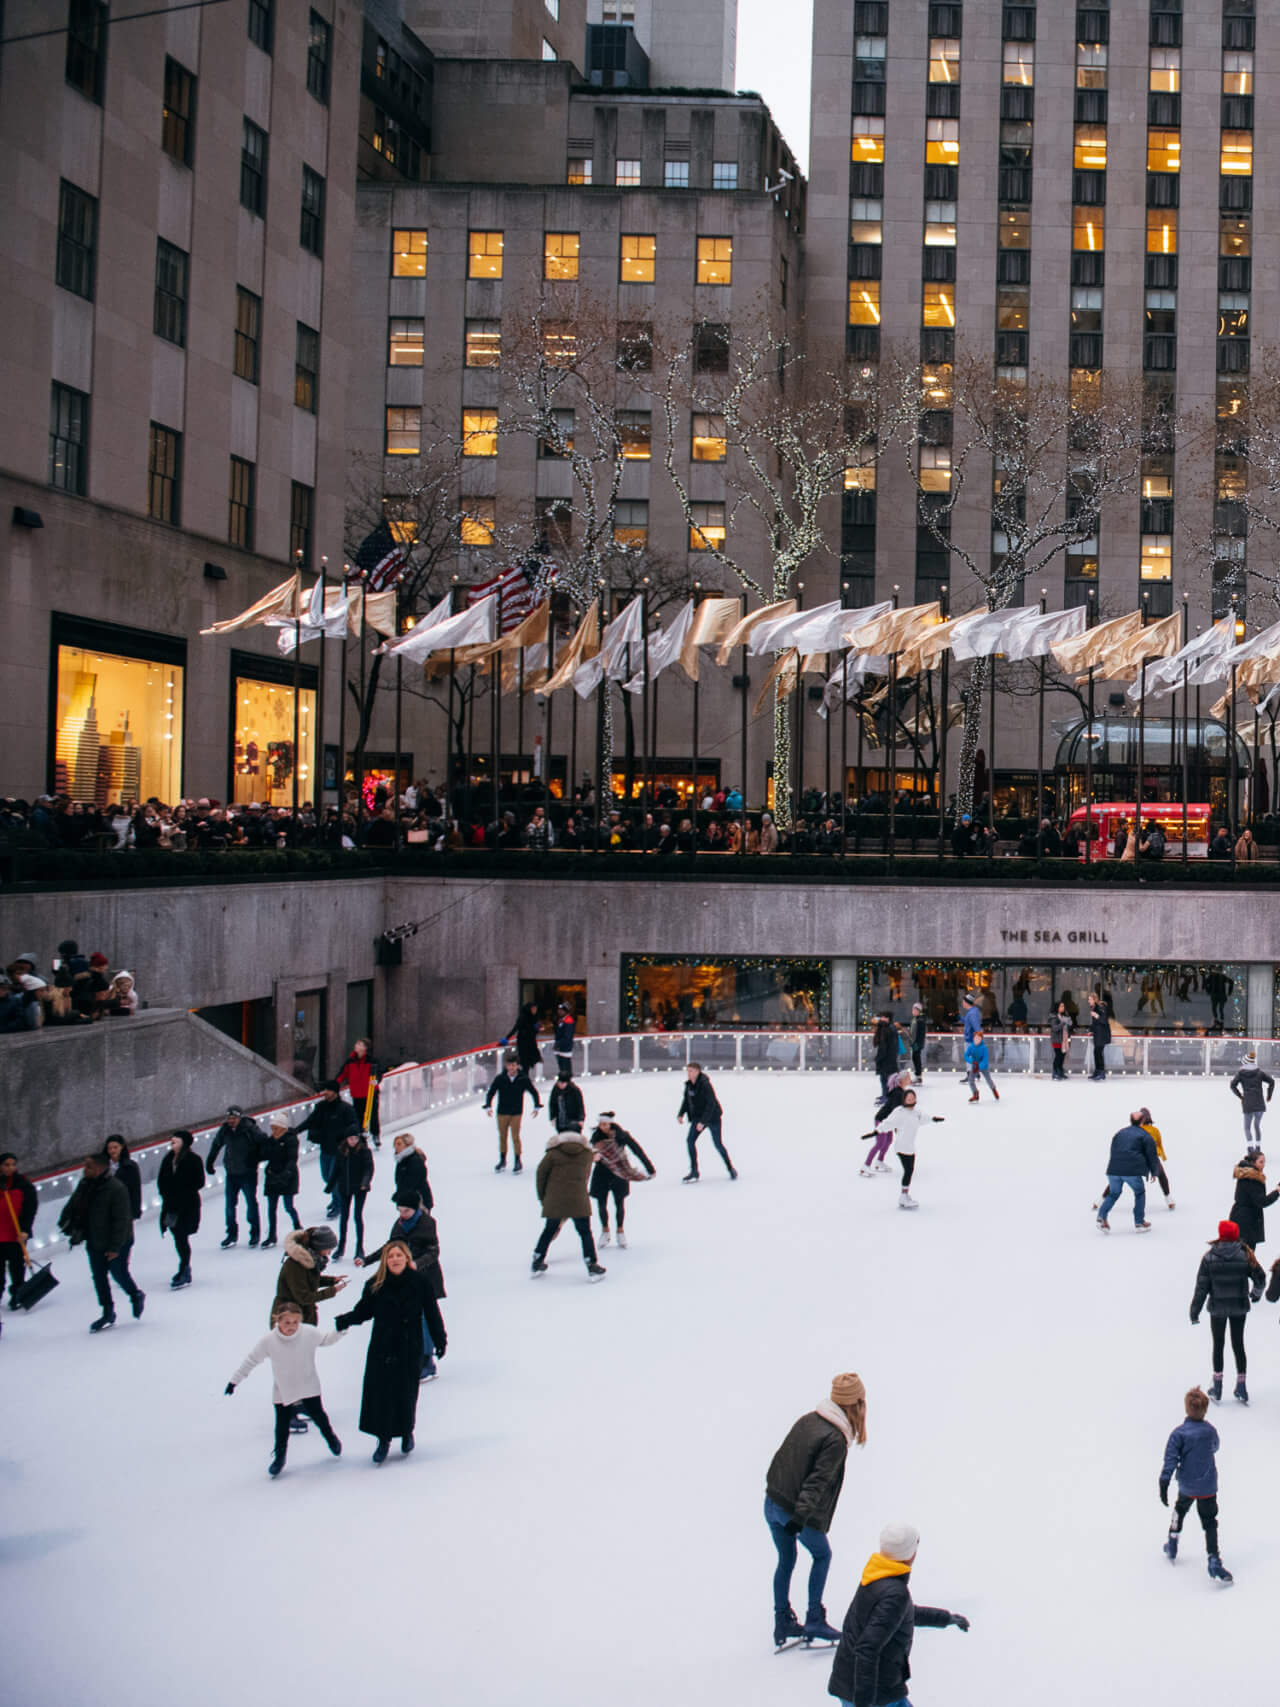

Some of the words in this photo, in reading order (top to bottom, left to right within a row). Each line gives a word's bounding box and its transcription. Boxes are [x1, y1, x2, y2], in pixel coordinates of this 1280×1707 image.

[999, 930, 1027, 943] THE
[1033, 930, 1061, 943] SEA
[1067, 931, 1108, 944] GRILL
